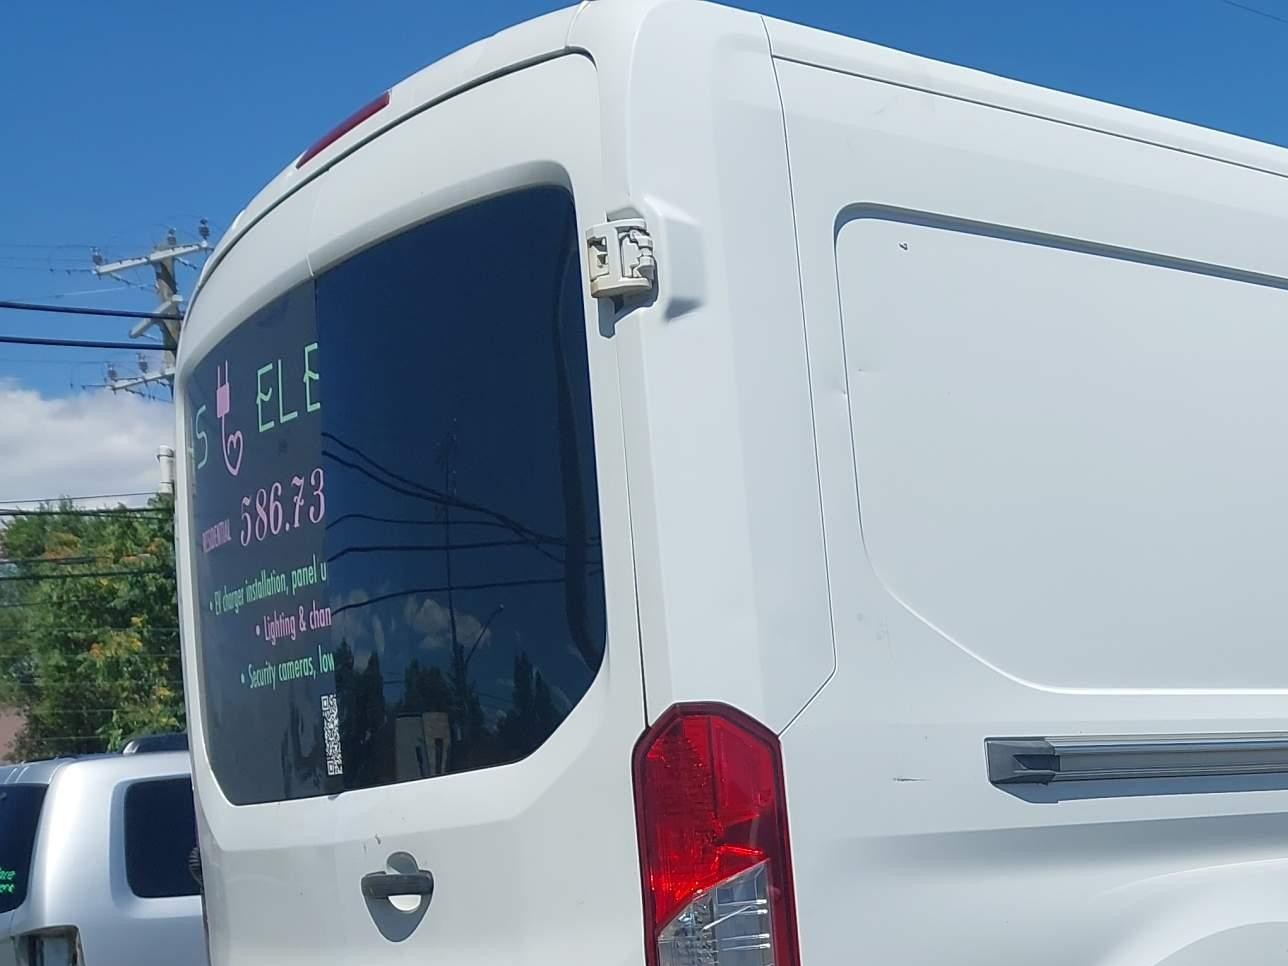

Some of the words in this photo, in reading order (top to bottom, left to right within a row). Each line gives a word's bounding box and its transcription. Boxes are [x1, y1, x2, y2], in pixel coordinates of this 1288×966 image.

[256, 342, 321, 433] ELE
[240, 468, 326, 547] 586.73
[222, 585, 244, 614] charger
[245, 569, 289, 602] installation,
[291, 553, 318, 596] panel
[263, 610, 297, 646] Lighting
[298, 605, 307, 633] &
[309, 599, 332, 630] chan
[248, 661, 277, 691] Security
[278, 655, 316, 682] cameras,
